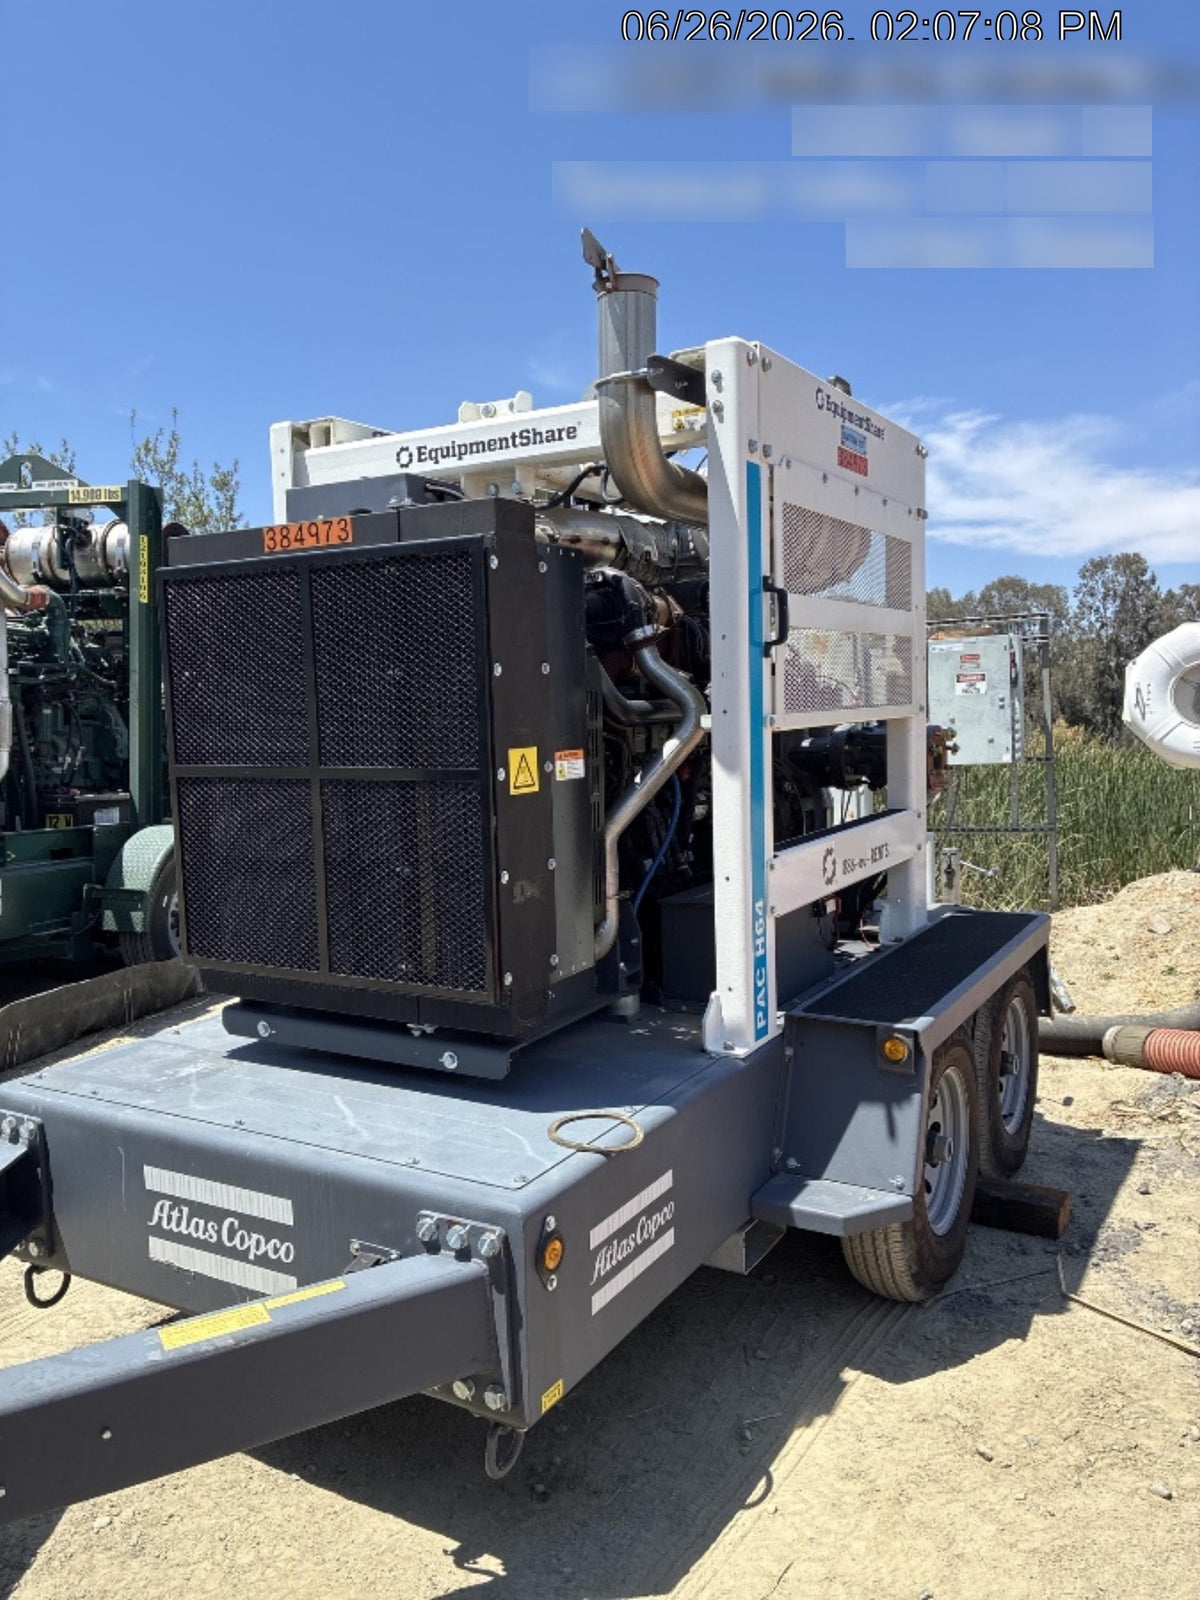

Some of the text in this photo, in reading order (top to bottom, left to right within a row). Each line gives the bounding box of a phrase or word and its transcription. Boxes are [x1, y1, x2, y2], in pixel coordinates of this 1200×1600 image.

[416, 425, 577, 464] EquipmentShare
[103, 487, 120, 501] lbs
[265, 518, 349, 550] 384973
[754, 899, 768, 1030] PAC H64
[147, 1199, 295, 1263] Atlas Copco
[590, 1200, 675, 1286] Atlas Copco
